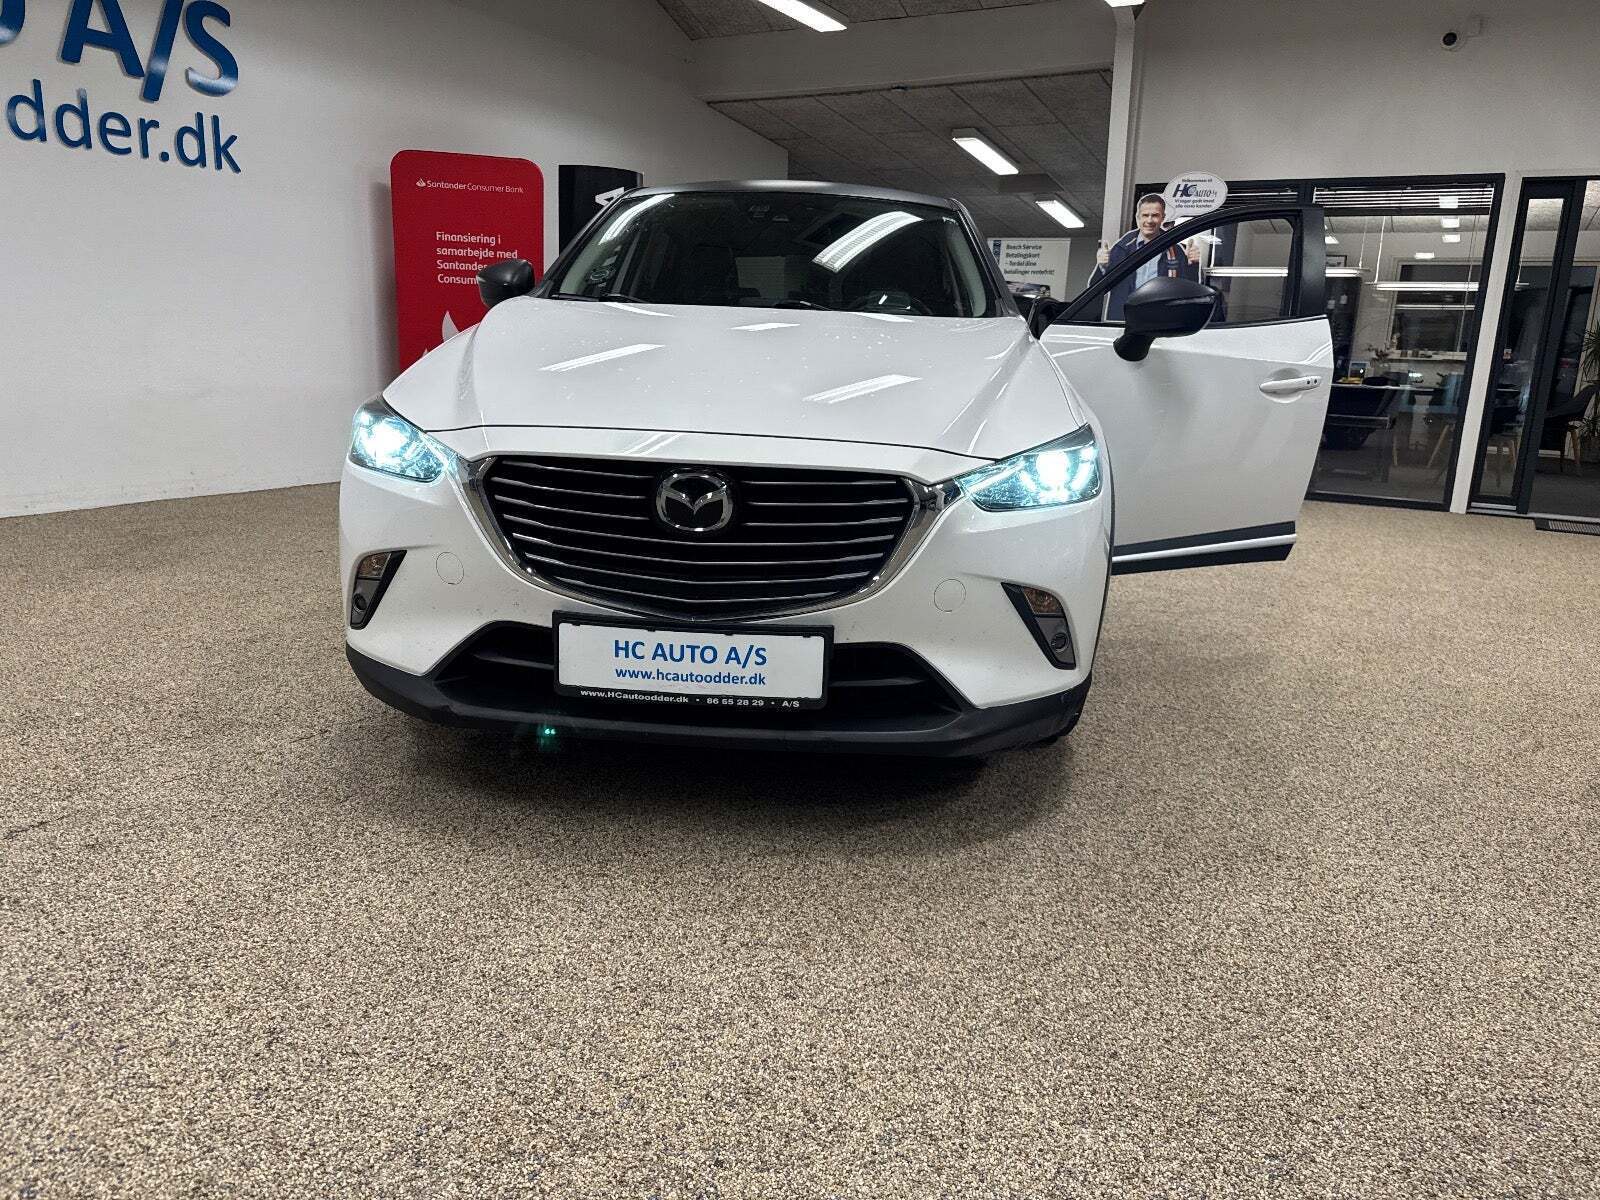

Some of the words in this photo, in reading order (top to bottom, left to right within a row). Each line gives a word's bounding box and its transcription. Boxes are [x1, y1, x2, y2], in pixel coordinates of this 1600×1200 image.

[59, 0, 238, 102] A/S
[7, 79, 241, 173] dder.dk
[505, 185, 524, 193] Bank
[436, 231, 496, 247] Finansiering
[498, 234, 501, 244] i
[436, 247, 494, 260] samarbejde
[496, 250, 518, 259] med
[436, 260, 487, 271] Santander
[437, 274, 479, 285] Consum
[614, 639, 645, 659] HC
[651, 642, 718, 665] AUTO
[724, 645, 768, 669] A/S
[615, 667, 766, 686] www.hcautoodder.dk
[580, 690, 689, 704] www.HCautoodder.dk
[706, 697, 719, 705] 86
[751, 699, 764, 707] 29
[781, 700, 800, 708] A/S
